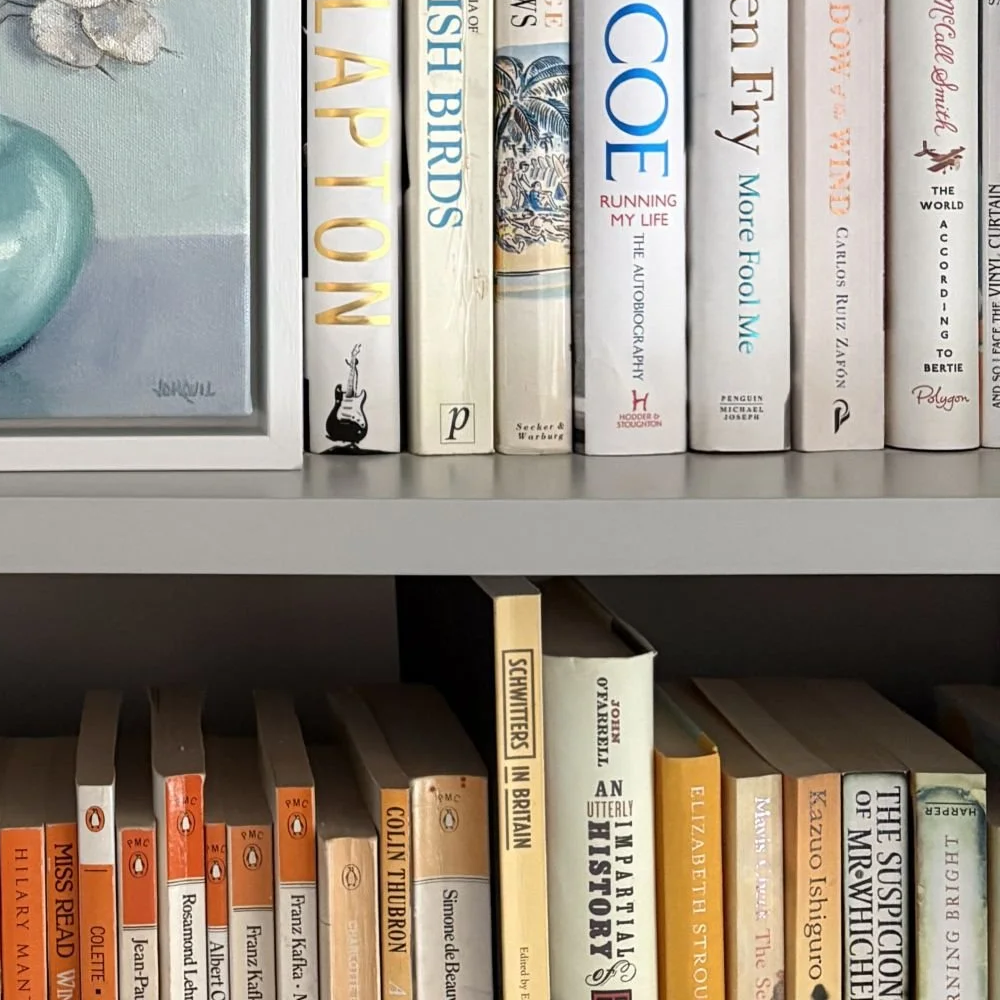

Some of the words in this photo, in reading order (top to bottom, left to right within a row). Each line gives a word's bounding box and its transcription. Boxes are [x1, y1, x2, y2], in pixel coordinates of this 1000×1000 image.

[468, 16, 479, 34] OF
[604, 2, 669, 182] COE
[714, 66, 774, 155] Fry
[931, 65, 958, 137] Smith
[427, 89, 464, 229] BIRDS
[829, 127, 852, 216] WIND
[600, 194, 677, 208] RUNNING
[739, 172, 761, 243] More
[920, 202, 964, 210] WORLD
[931, 186, 955, 195] THE
[611, 213, 635, 226] MY
[641, 213, 668, 226] LIFE
[633, 233, 645, 260] THE
[835, 226, 849, 288] CARLOS
[739, 249, 761, 305] Fool
[632, 264, 645, 381] AUTOBIOGRAPHY
[739, 313, 761, 355] Me
[836, 293, 849, 332] RUIZ
[923, 364, 963, 373] BERTIE
[937, 349, 953, 358] TO
[721, 395, 763, 403] PENGUIN
[912, 385, 970, 411] Polygon
[509, 658, 530, 750] SCHWITTERS
[611, 699, 621, 744] JOHN
[512, 765, 531, 782] IN
[595, 780, 624, 797] AN
[512, 788, 532, 849] BRITAIN
[587, 800, 634, 818] UTTERLY
[809, 789, 828, 871] Kazuo
[855, 790, 872, 819] OF
[876, 785, 902, 844] THE
[926, 806, 977, 817] HARPER
[386, 807, 405, 861] COLIN
[690, 786, 706, 913] ELIZABETH
[15, 848, 30, 930] HILARY
[55, 843, 74, 893] MISS
[588, 821, 613, 960] HISTORY
[614, 821, 635, 958] IMPARTIAL
[944, 835, 960, 921] BRIGHT
[56, 899, 75, 958] READ
[182, 893, 197, 964] Rosamond
[291, 894, 306, 934] Franz
[388, 868, 408, 953] THUBRON
[443, 889, 458, 941] Simone
[803, 876, 829, 980] Ishiguro
[90, 926, 106, 982] COLETTE
[209, 941, 225, 986] Albert
[247, 925, 262, 967] Franz
[291, 938, 308, 980] Kafka
[445, 943, 460, 961] de
[519, 946, 529, 976] Edited
